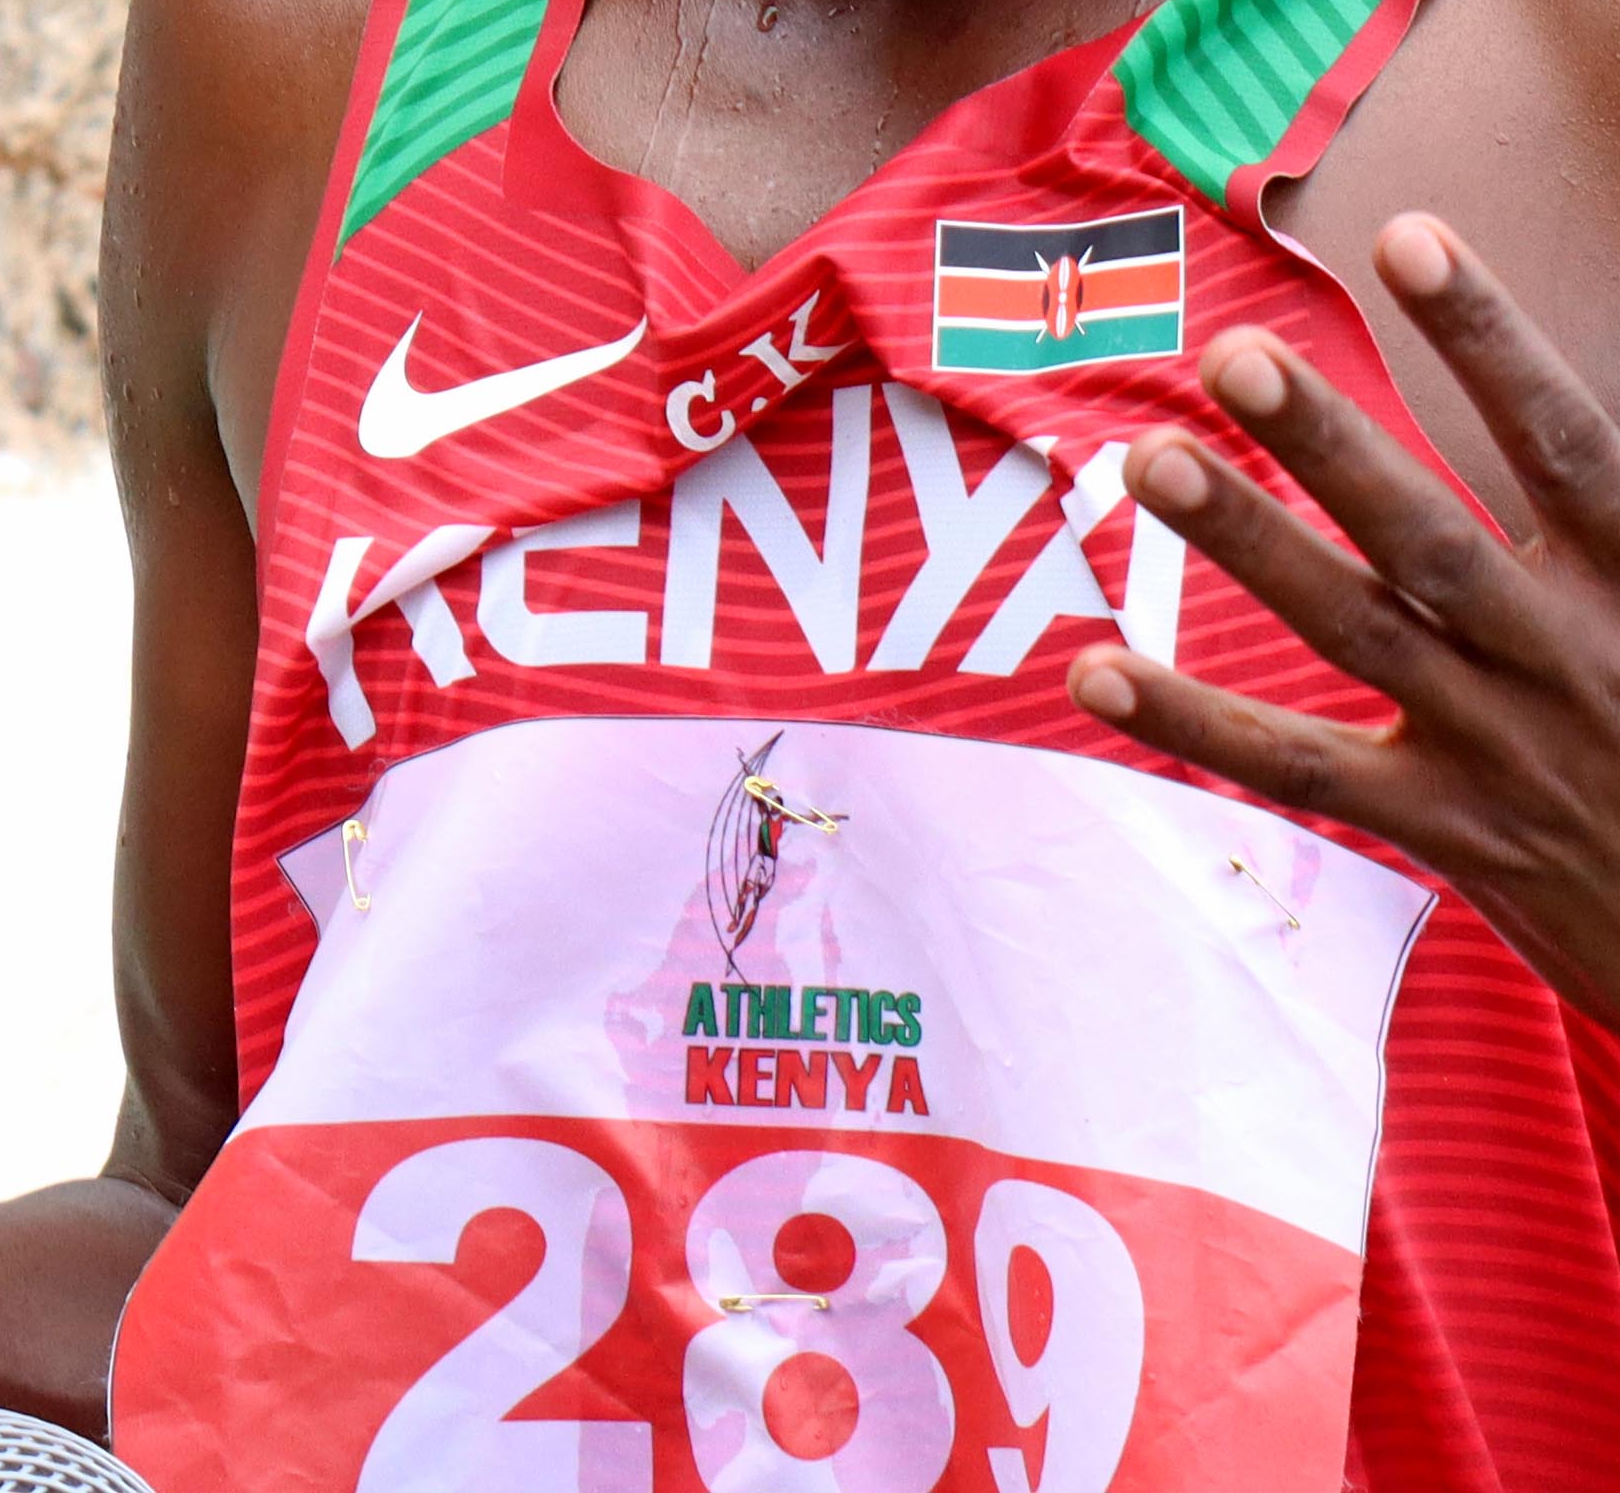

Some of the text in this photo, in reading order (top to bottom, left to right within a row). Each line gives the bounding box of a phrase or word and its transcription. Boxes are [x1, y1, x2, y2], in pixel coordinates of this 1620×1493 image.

[306, 381, 1187, 751] KENYA
[682, 982, 922, 1048] ATHLETICS
[684, 1045, 930, 1116] KENYA
[351, 1135, 1147, 1493] 289
